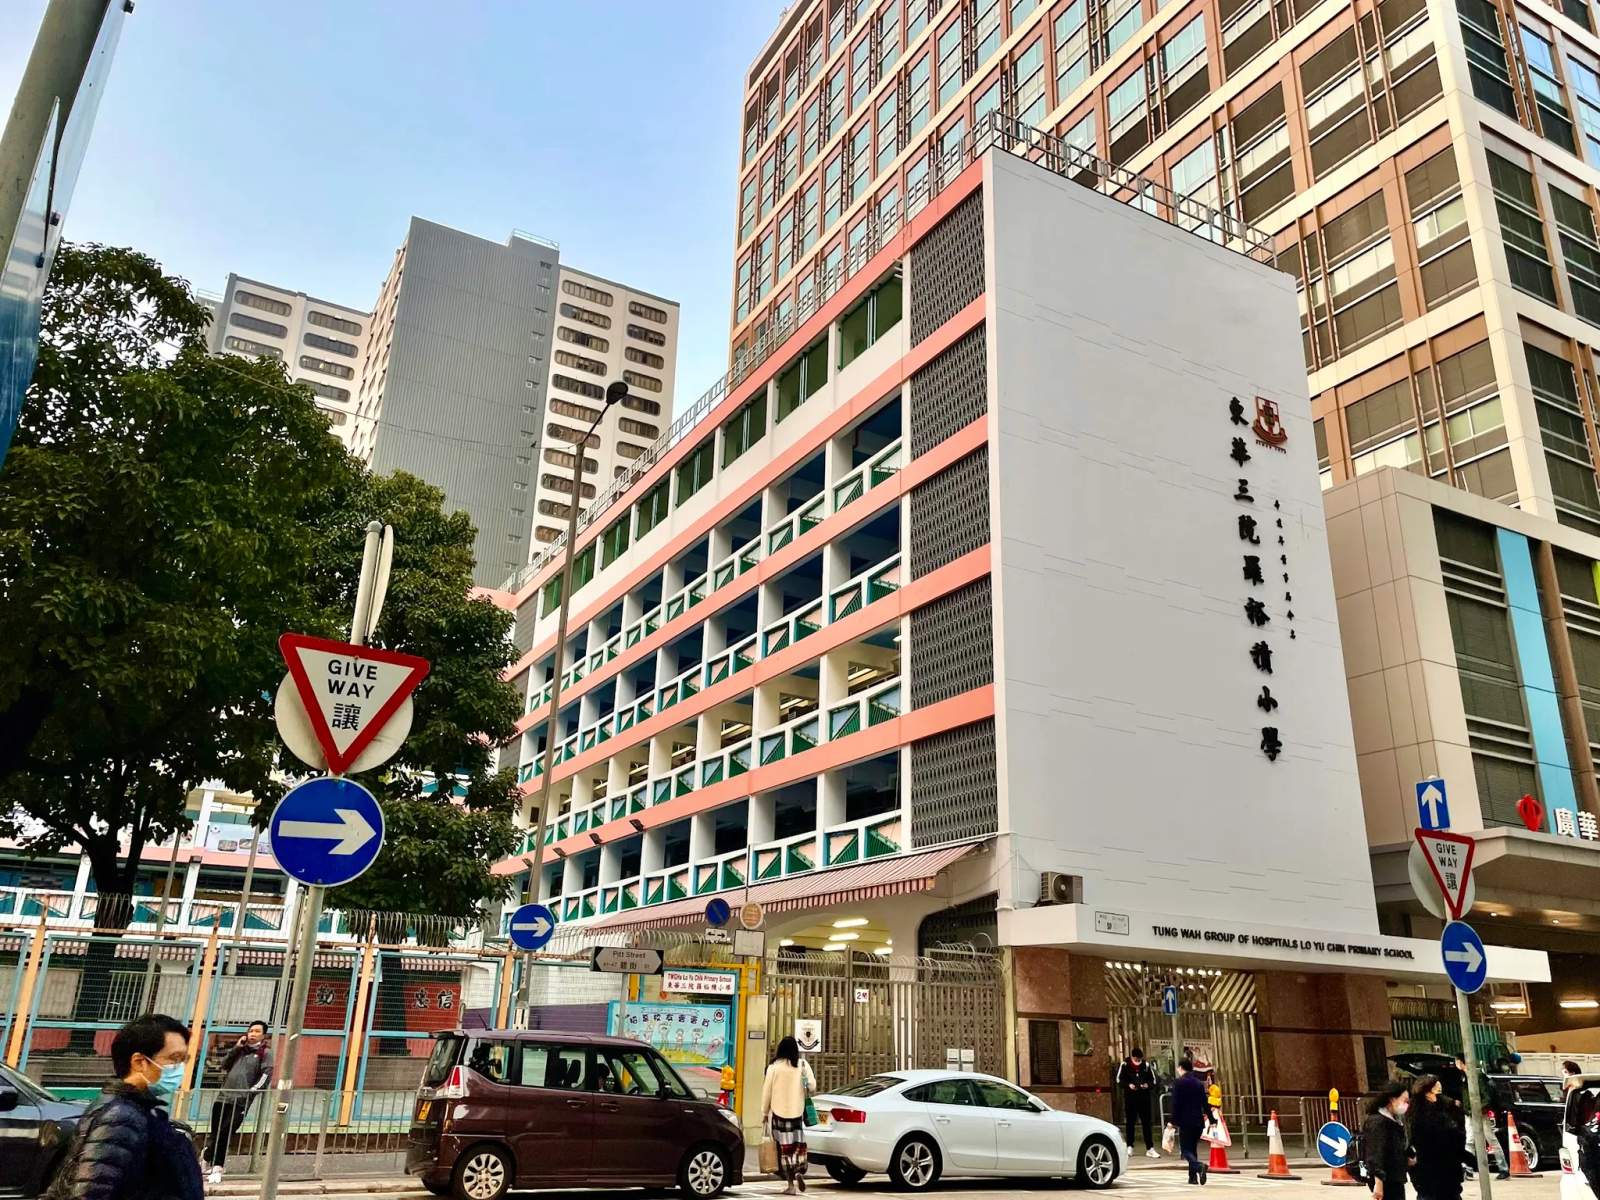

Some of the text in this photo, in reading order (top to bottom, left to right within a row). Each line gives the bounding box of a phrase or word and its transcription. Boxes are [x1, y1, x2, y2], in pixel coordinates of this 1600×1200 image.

[328, 659, 378, 680] GIVE
[328, 679, 375, 699] WAY
[332, 703, 361, 731] 讓
[1554, 808, 1600, 841] 廣華
[1436, 843, 1457, 855] GIVE
[1439, 857, 1458, 868] WAY
[1445, 872, 1458, 890] 讓
[1152, 926, 1414, 959] TUNG WAH GROUP OF HOSPITALS LO YU CHIK PRIMARY SCHOOL
[613, 951, 624, 959] Pitt
[704, 975, 718, 983] Primary
